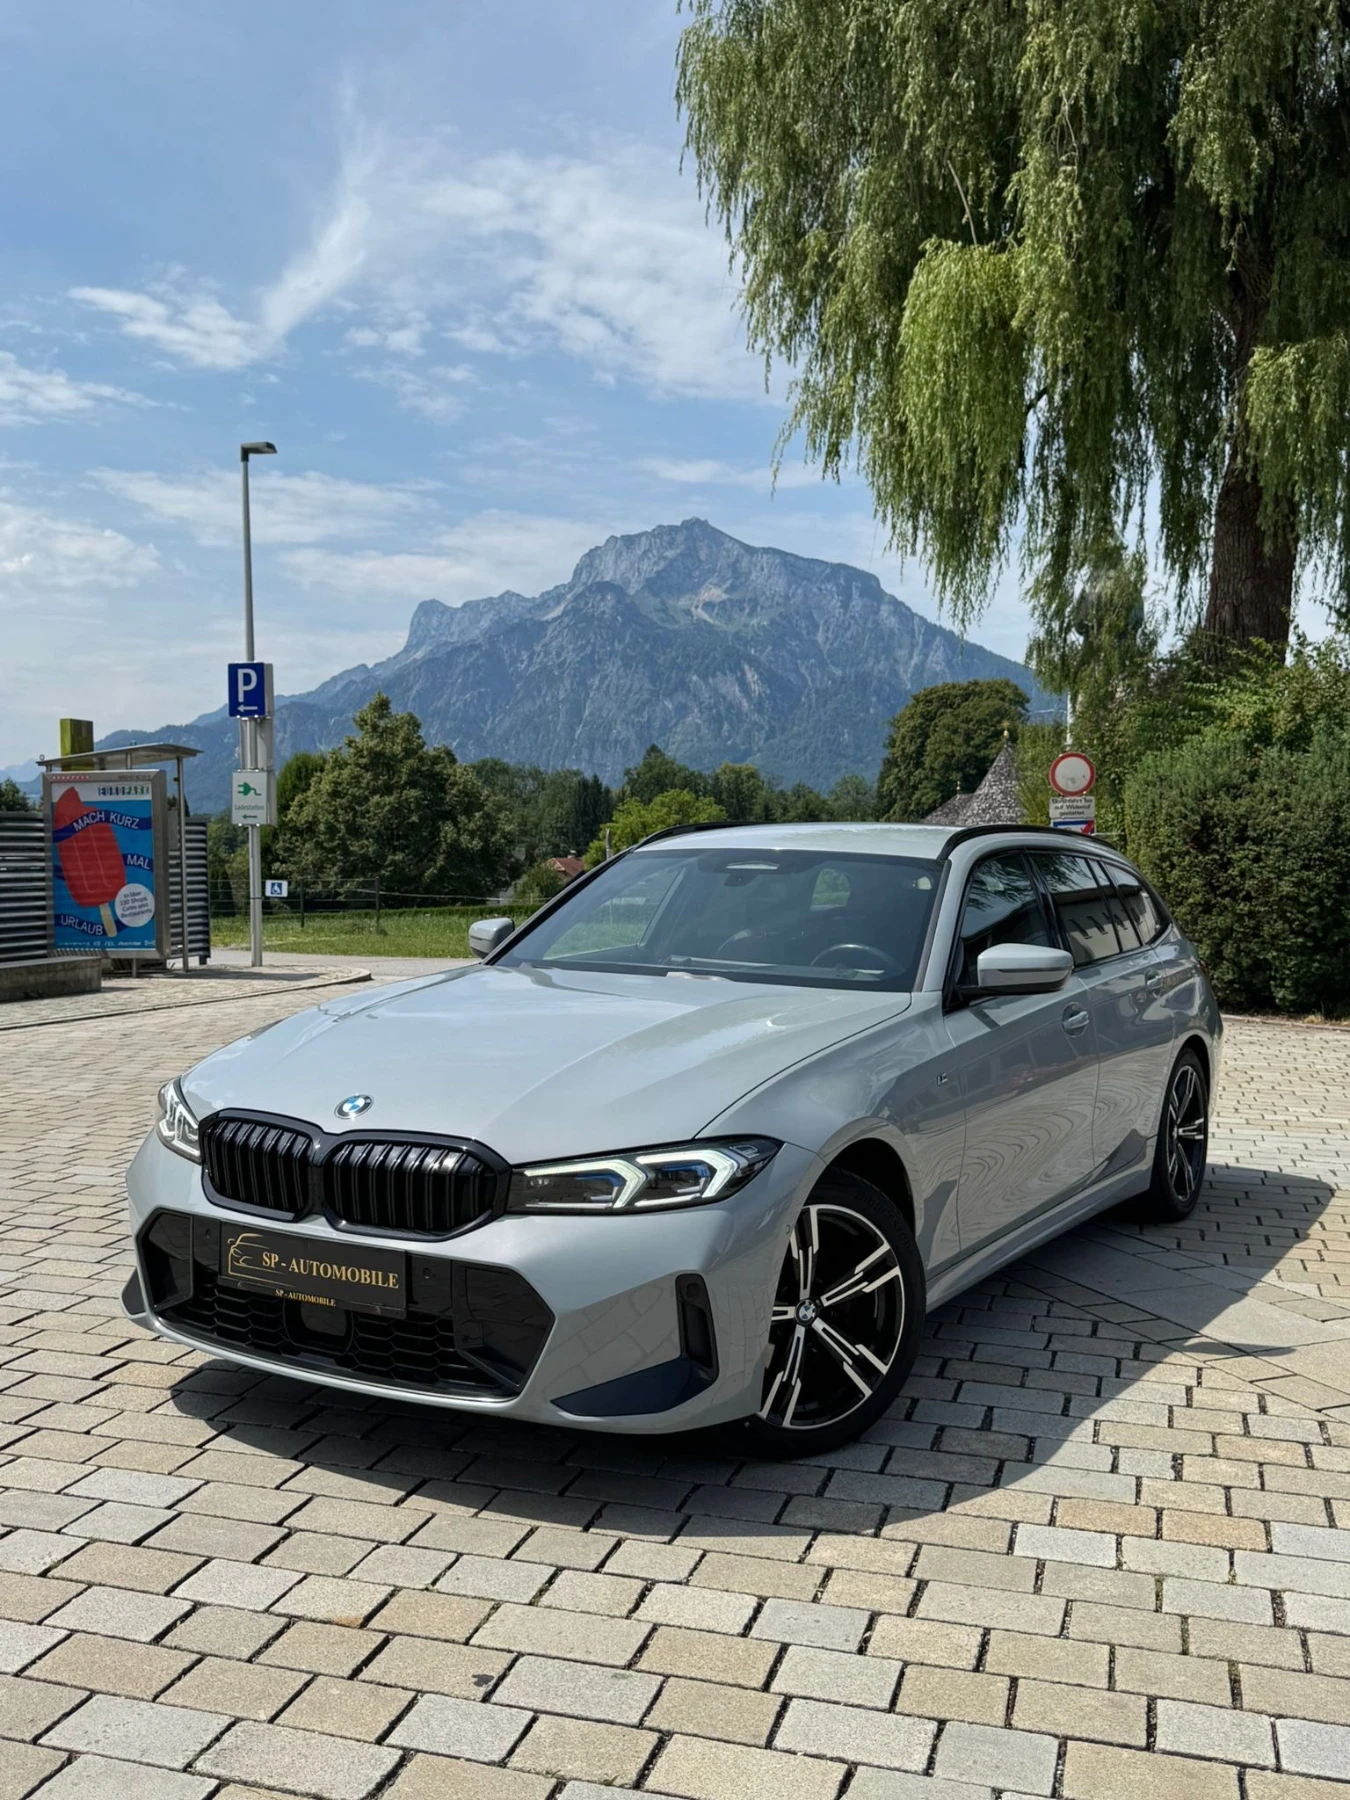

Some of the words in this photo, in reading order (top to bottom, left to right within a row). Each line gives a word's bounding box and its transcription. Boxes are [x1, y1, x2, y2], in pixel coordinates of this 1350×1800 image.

[237, 668, 257, 703] P
[73, 811, 105, 831] MACH
[109, 812, 140, 829] KURZ
[126, 854, 150, 870] MAL
[60, 914, 104, 936] URLAUB
[262, 1251, 279, 1268] SP
[289, 1258, 399, 1288] AUTOMOBILE
[288, 1292, 336, 1306] AUTOMOBILE
